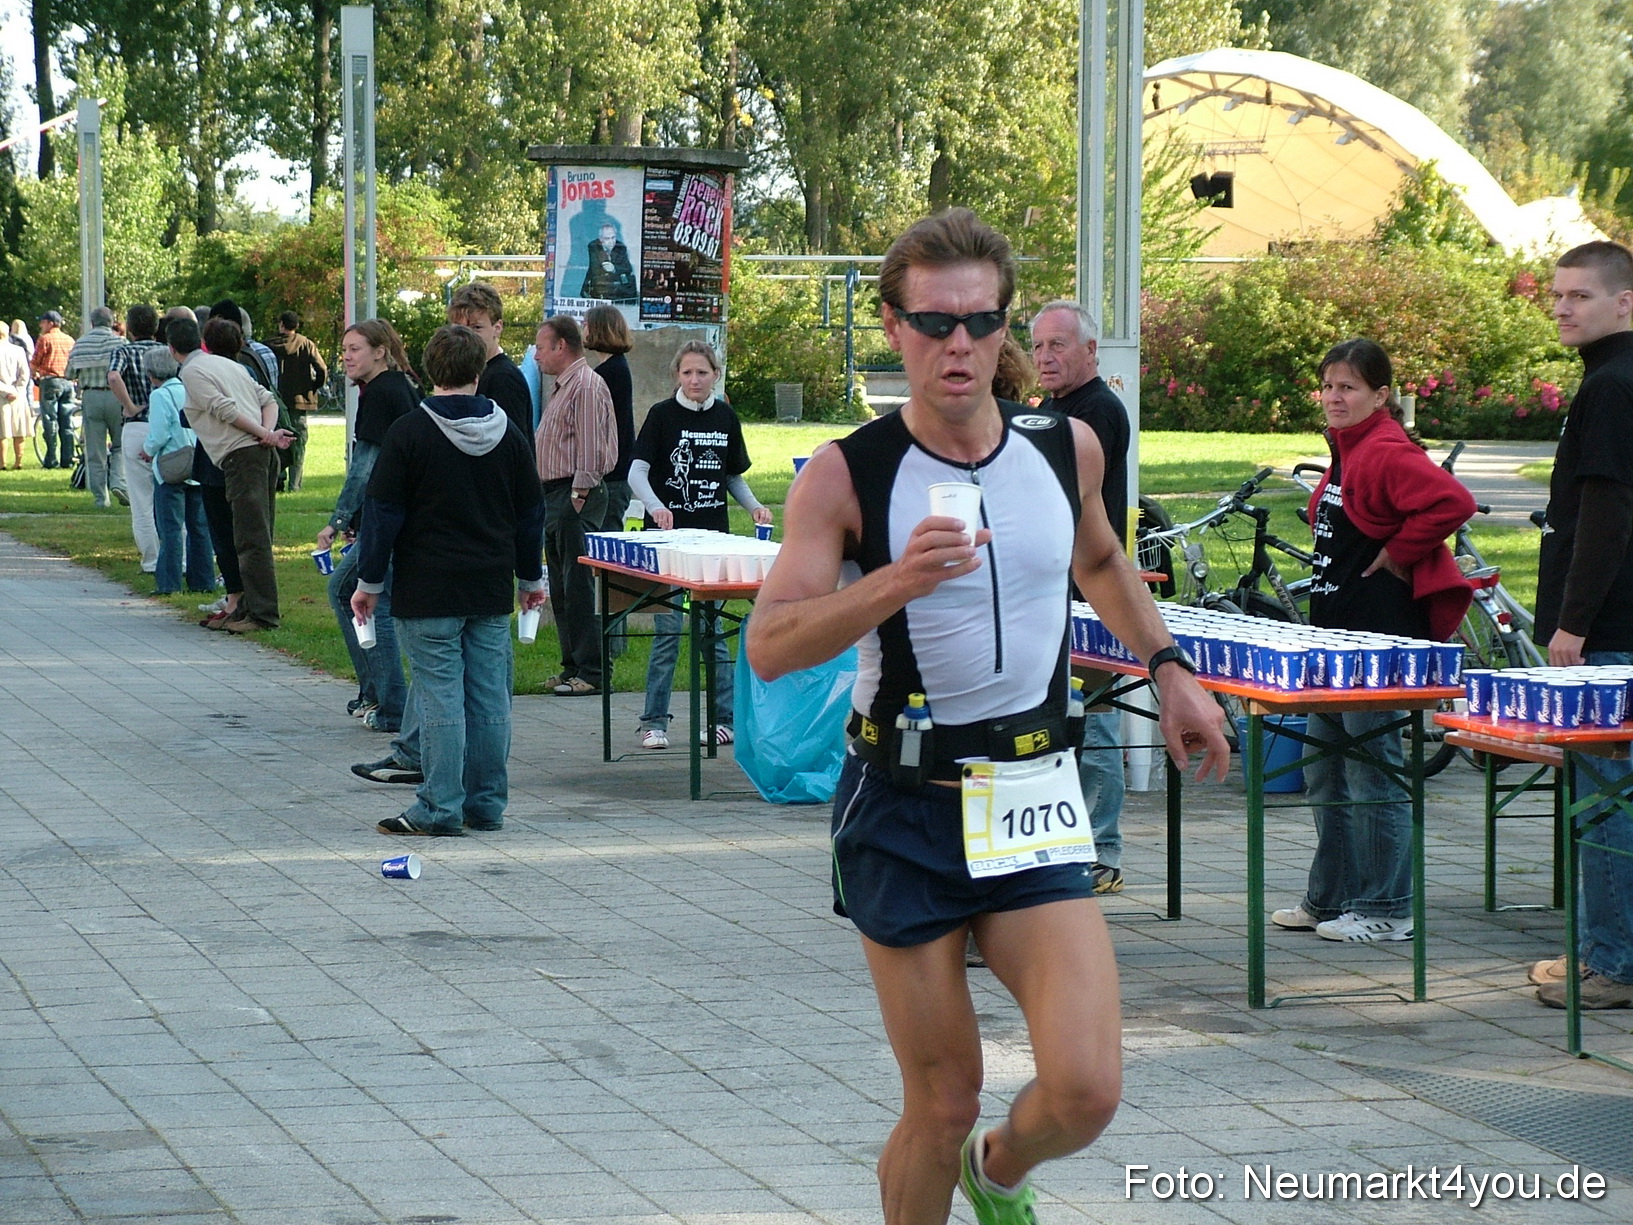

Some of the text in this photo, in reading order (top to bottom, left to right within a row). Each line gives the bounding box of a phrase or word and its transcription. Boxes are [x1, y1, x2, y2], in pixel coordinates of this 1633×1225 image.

[568, 171, 595, 182] Bruno
[561, 179, 615, 209] Jonas
[680, 195, 724, 240] ROCK
[674, 222, 720, 260] 08.09.07
[681, 430, 728, 440] Neumarkter
[1002, 801, 1077, 839] 1070
[1049, 845, 1092, 858] PFLEIDERER
[971, 856, 1019, 872] BOCK
